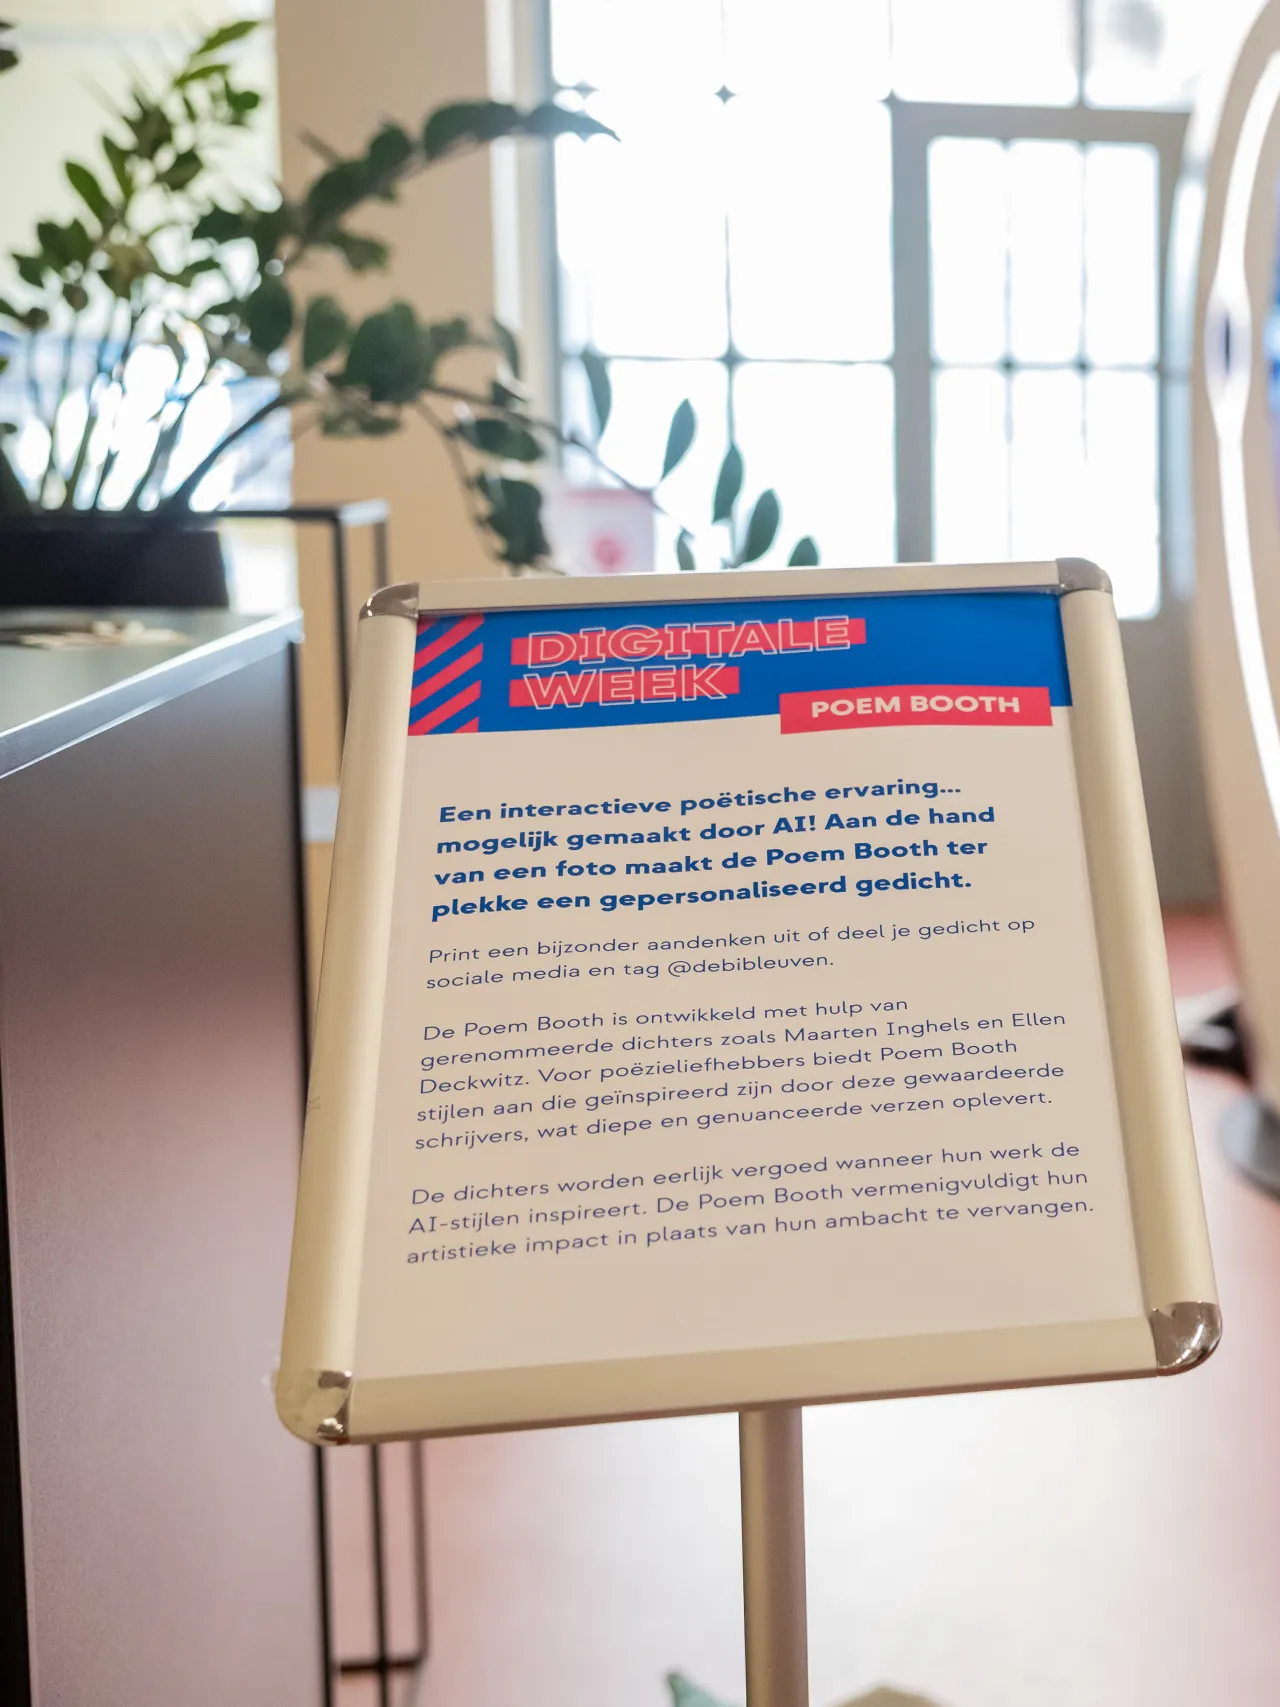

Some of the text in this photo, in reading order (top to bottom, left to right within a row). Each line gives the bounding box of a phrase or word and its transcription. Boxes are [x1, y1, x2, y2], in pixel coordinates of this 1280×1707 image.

[527, 616, 850, 668] DIGITALE
[523, 663, 728, 711] WEEK
[810, 695, 1020, 718] POEM BOOTH
[439, 778, 961, 823] Een interactieve poëtische ervaring...
[436, 806, 995, 855] mogelijk gemaakt door AI! Aan de hand
[433, 839, 988, 885] van een foto maakt de Poem Booth ter
[431, 870, 971, 922] plekke een gepersonaliseerd gedicht.
[429, 919, 1034, 963] Print een bijzonder aandenken uit of deel je gedicht op
[426, 955, 833, 988] sociale media en tag @debibleuven.
[420, 1012, 1065, 1071] gerenommeerde dichters zoals Maarten Inghels en Ellen
[423, 1000, 907, 1040] De Poem Booth is ontwikkeld met hulp van
[420, 1038, 1016, 1094] Deckwitz. Voor poëzieliefhebbers biedt Poem Booth
[417, 1062, 1064, 1124] stijlen aan die geïnspireerd zijn door deze gewaardeerde
[415, 1091, 1051, 1149] schrijvers, wat diepe en genuanceerde verzen oplevert.
[412, 1141, 1079, 1205] De dichters worden eerlijk vergoed wanneer hun werk de
[408, 1170, 1087, 1234] AI-stijlen inspireert. De Poem Booth vermenigvuldigt hun
[406, 1201, 1093, 1263] artistieke impact in plaats van hun ambacht te vervangen.
